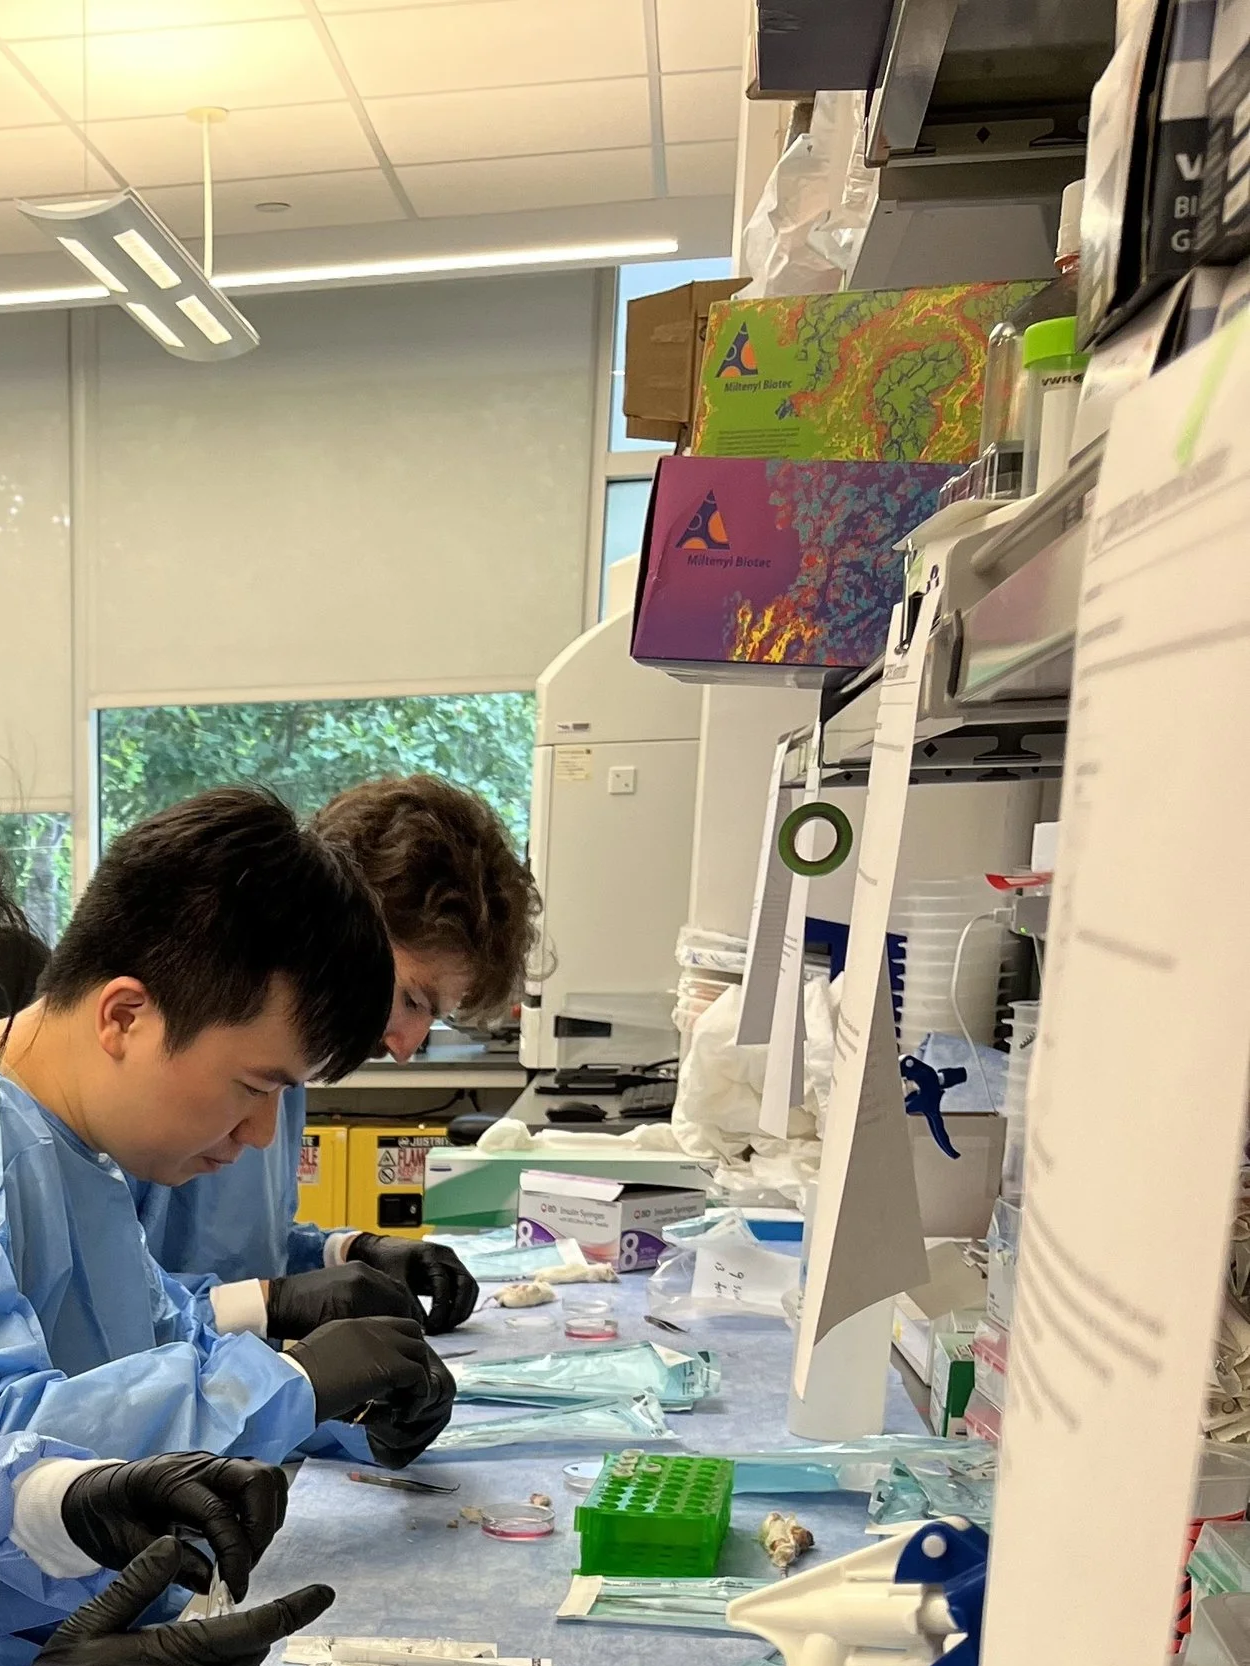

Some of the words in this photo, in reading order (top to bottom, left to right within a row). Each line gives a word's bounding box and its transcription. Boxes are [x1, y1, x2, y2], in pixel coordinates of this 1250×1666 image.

[724, 380, 761, 393] Miltenyi
[763, 378, 793, 390] Biotec
[687, 554, 733, 568] Miltenyi
[735, 555, 772, 568] Biotec
[620, 1232, 639, 1270] 8
